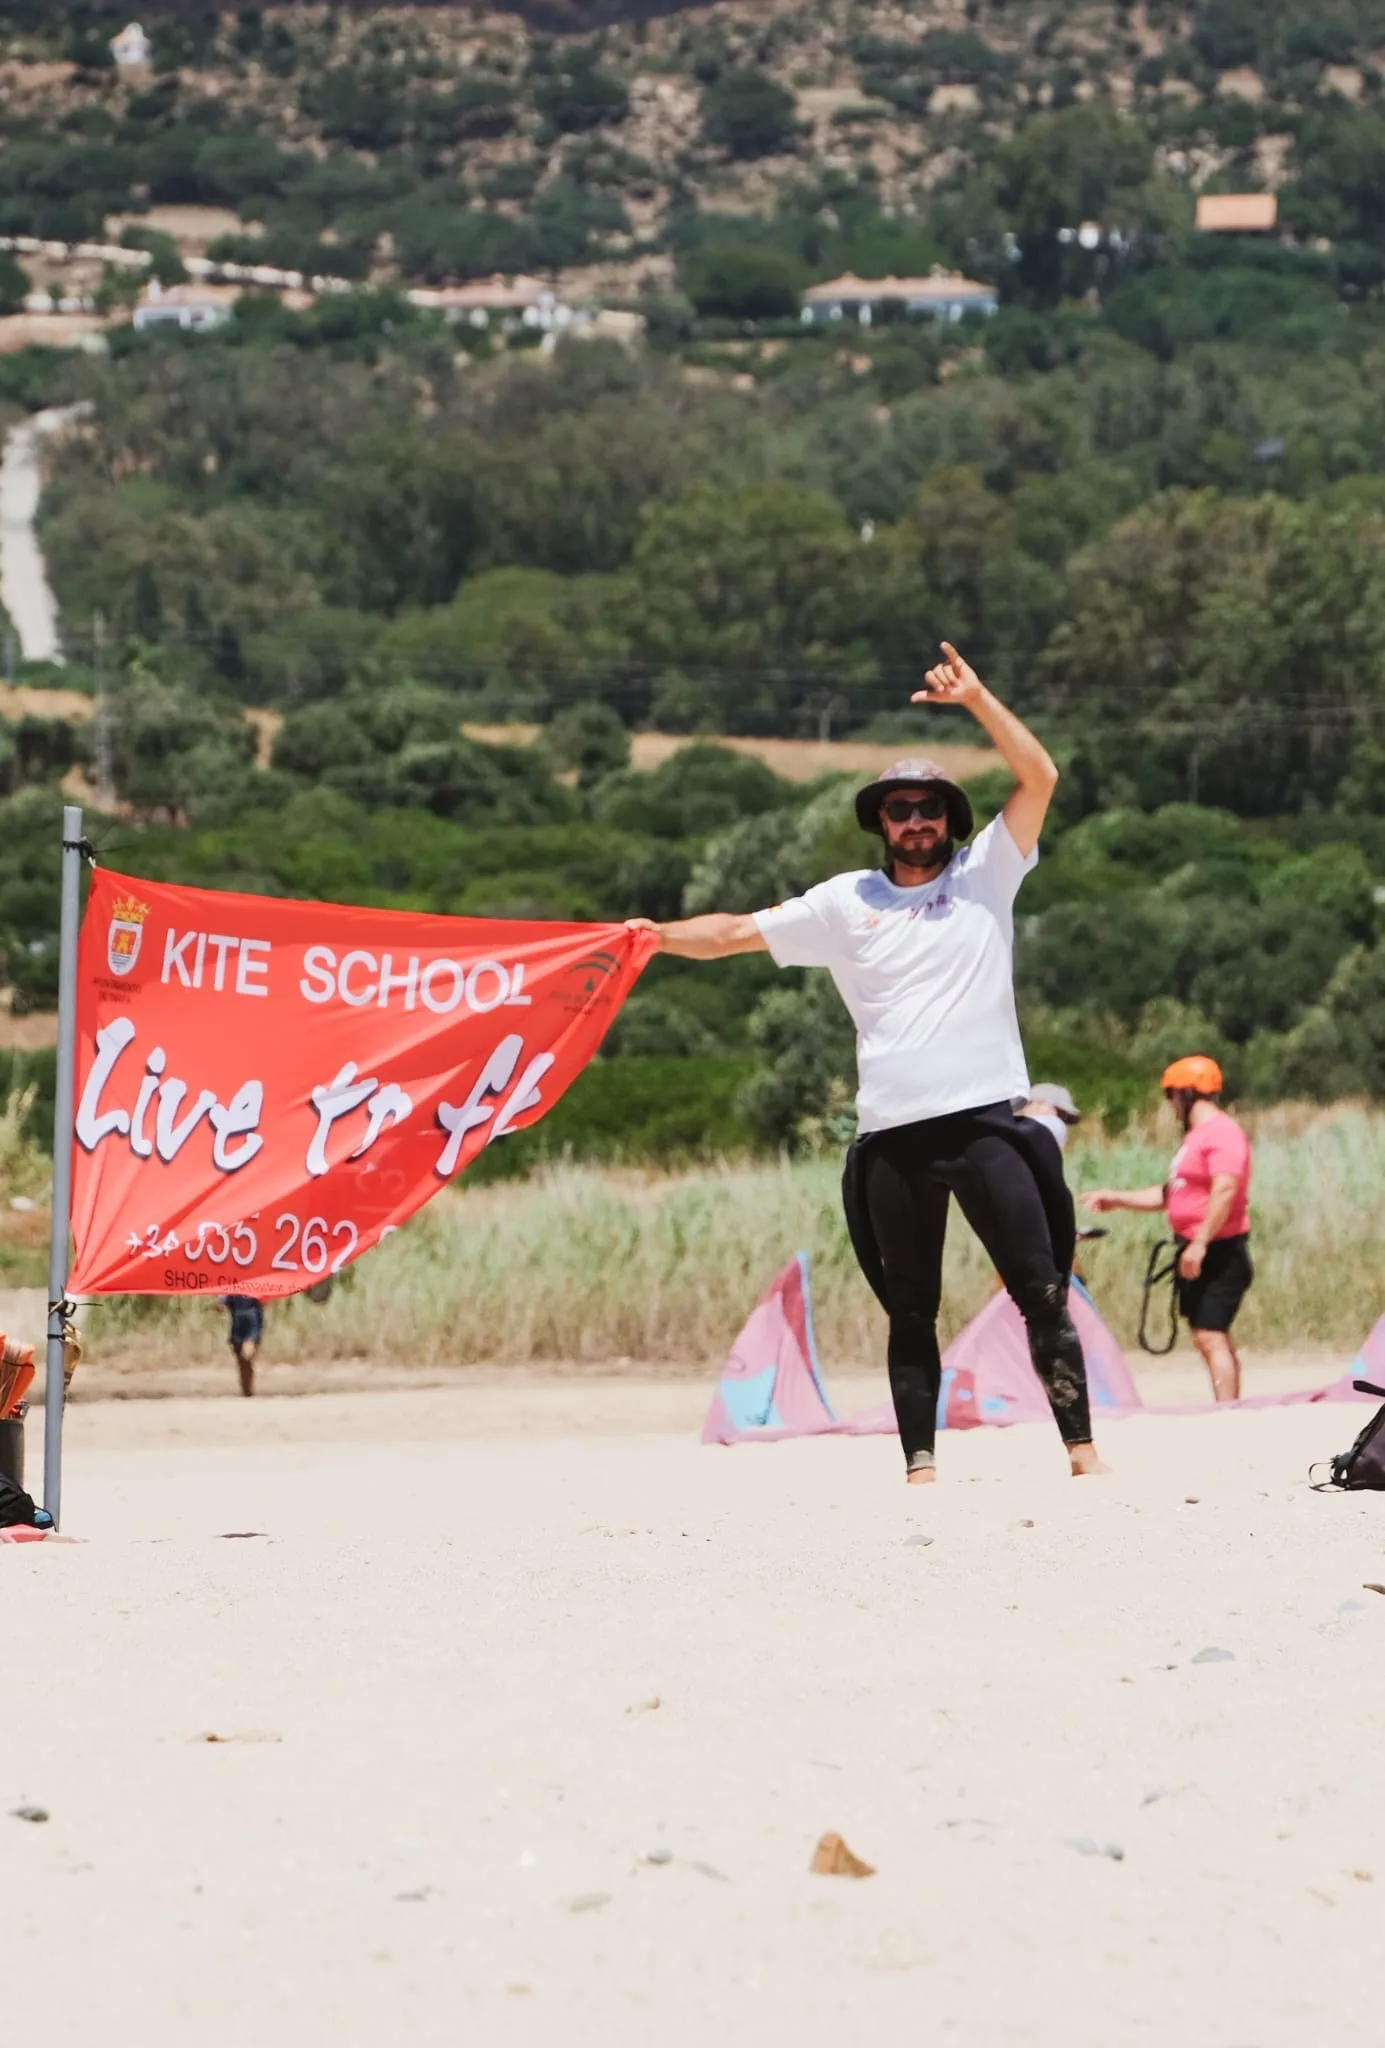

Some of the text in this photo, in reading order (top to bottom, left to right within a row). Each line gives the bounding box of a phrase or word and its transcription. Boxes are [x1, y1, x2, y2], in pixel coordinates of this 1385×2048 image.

[161, 927, 532, 1014] KITE SCHOOL
[74, 1017, 264, 1173] Live
[271, 1213, 358, 1273] 262
